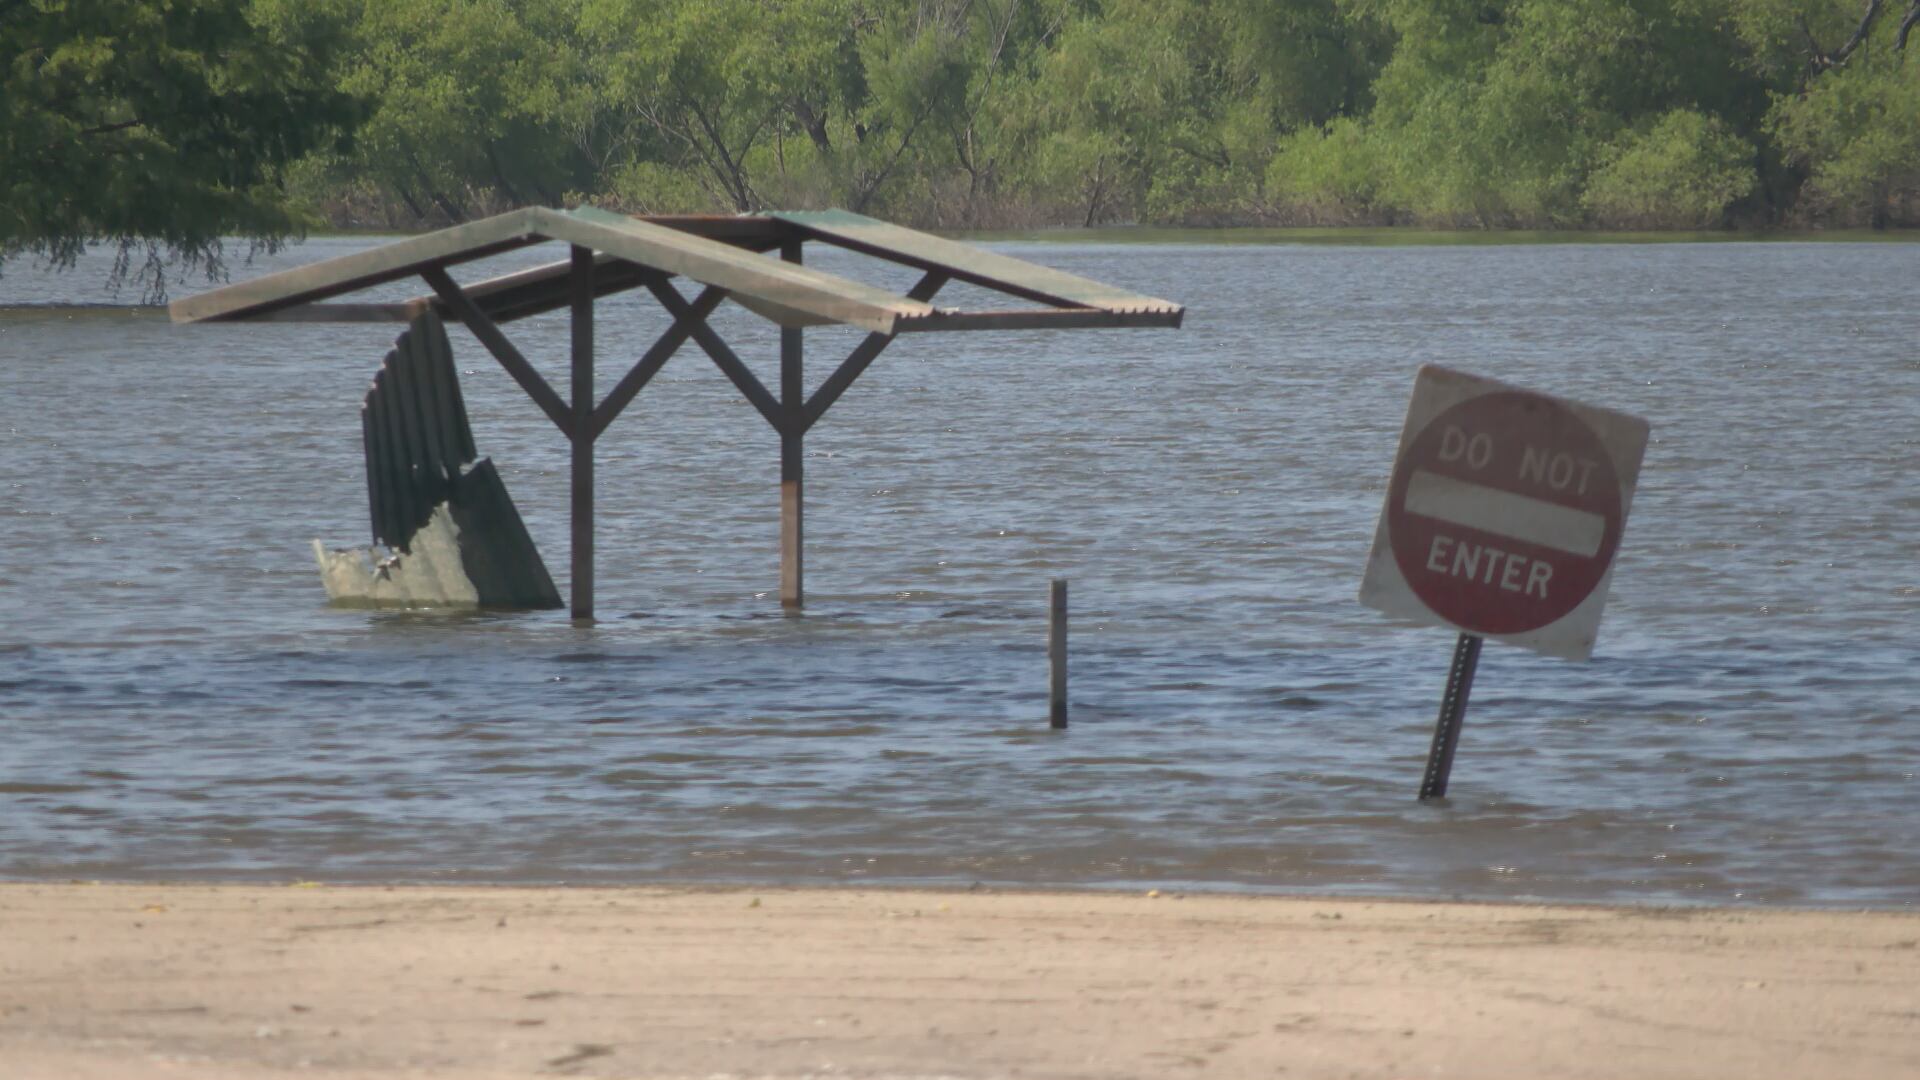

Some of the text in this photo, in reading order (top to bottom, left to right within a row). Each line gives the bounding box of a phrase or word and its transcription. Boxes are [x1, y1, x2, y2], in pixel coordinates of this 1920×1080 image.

[1437, 424, 1599, 495] DO NOT
[1426, 534, 1554, 600] ENTER
